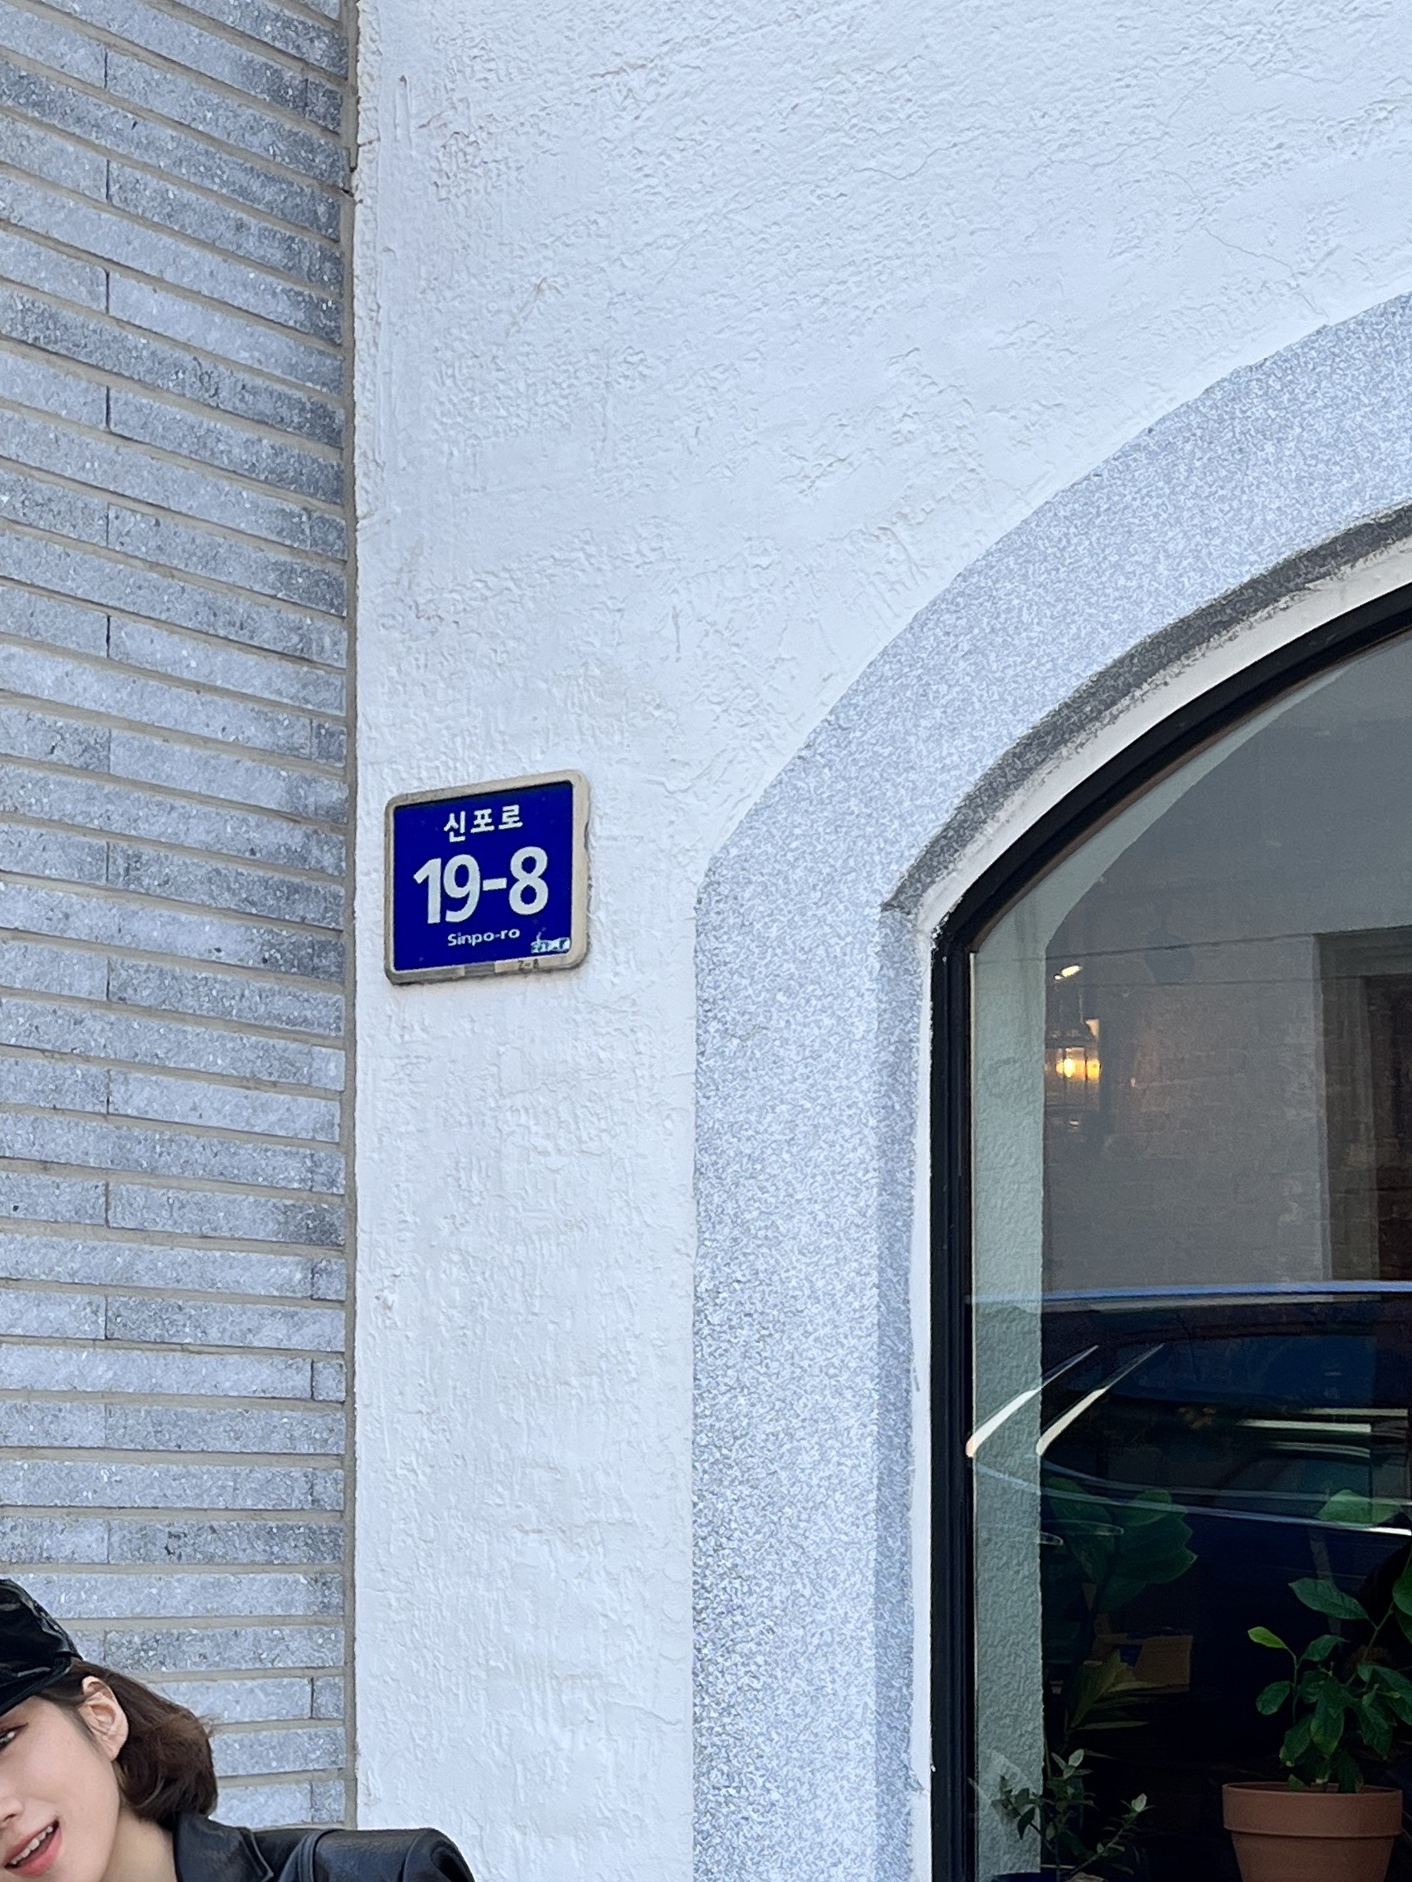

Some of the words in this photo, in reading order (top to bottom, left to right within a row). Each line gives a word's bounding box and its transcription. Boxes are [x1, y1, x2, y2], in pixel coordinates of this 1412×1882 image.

[443, 804, 524, 843] 신포로
[413, 846, 549, 925] 19-8
[447, 928, 521, 947] Sinpo-ro
